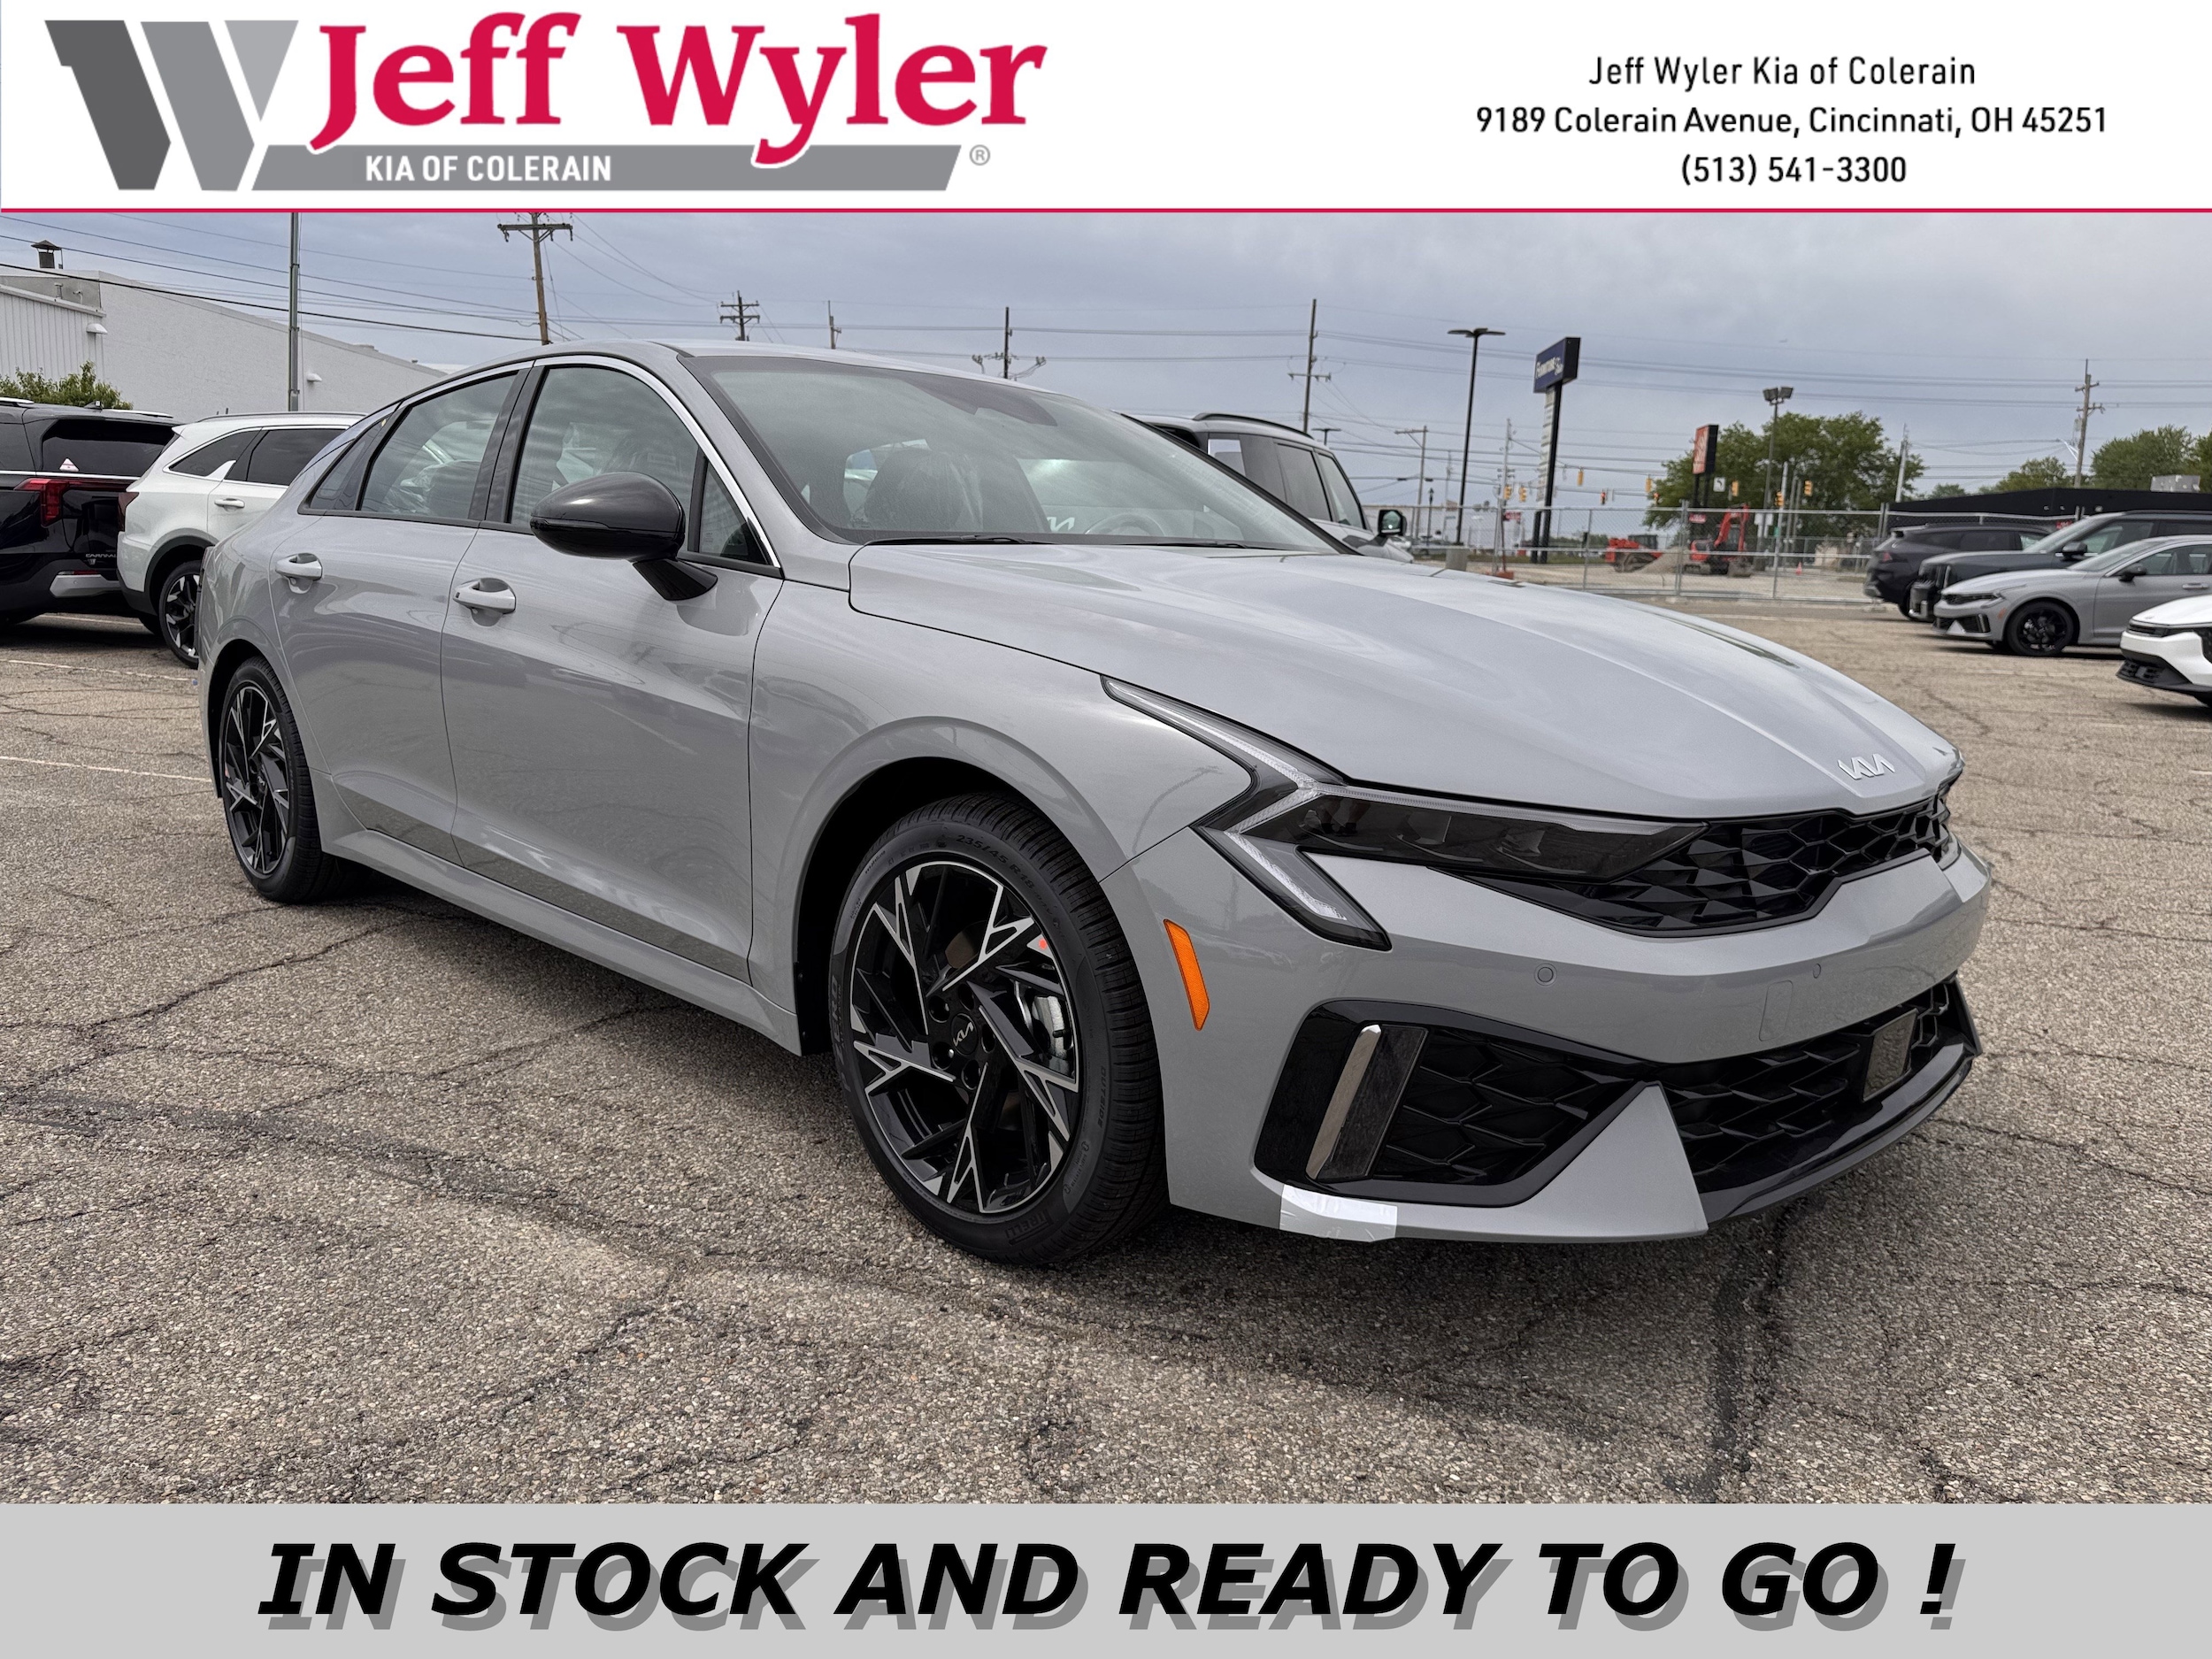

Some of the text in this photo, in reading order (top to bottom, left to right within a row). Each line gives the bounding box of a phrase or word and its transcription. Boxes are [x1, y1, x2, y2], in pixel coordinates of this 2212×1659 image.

[1837, 753, 1896, 780] KIA
[952, 1021, 974, 1047] KIA
[1004, 1208, 1055, 1246] PIRELLI
